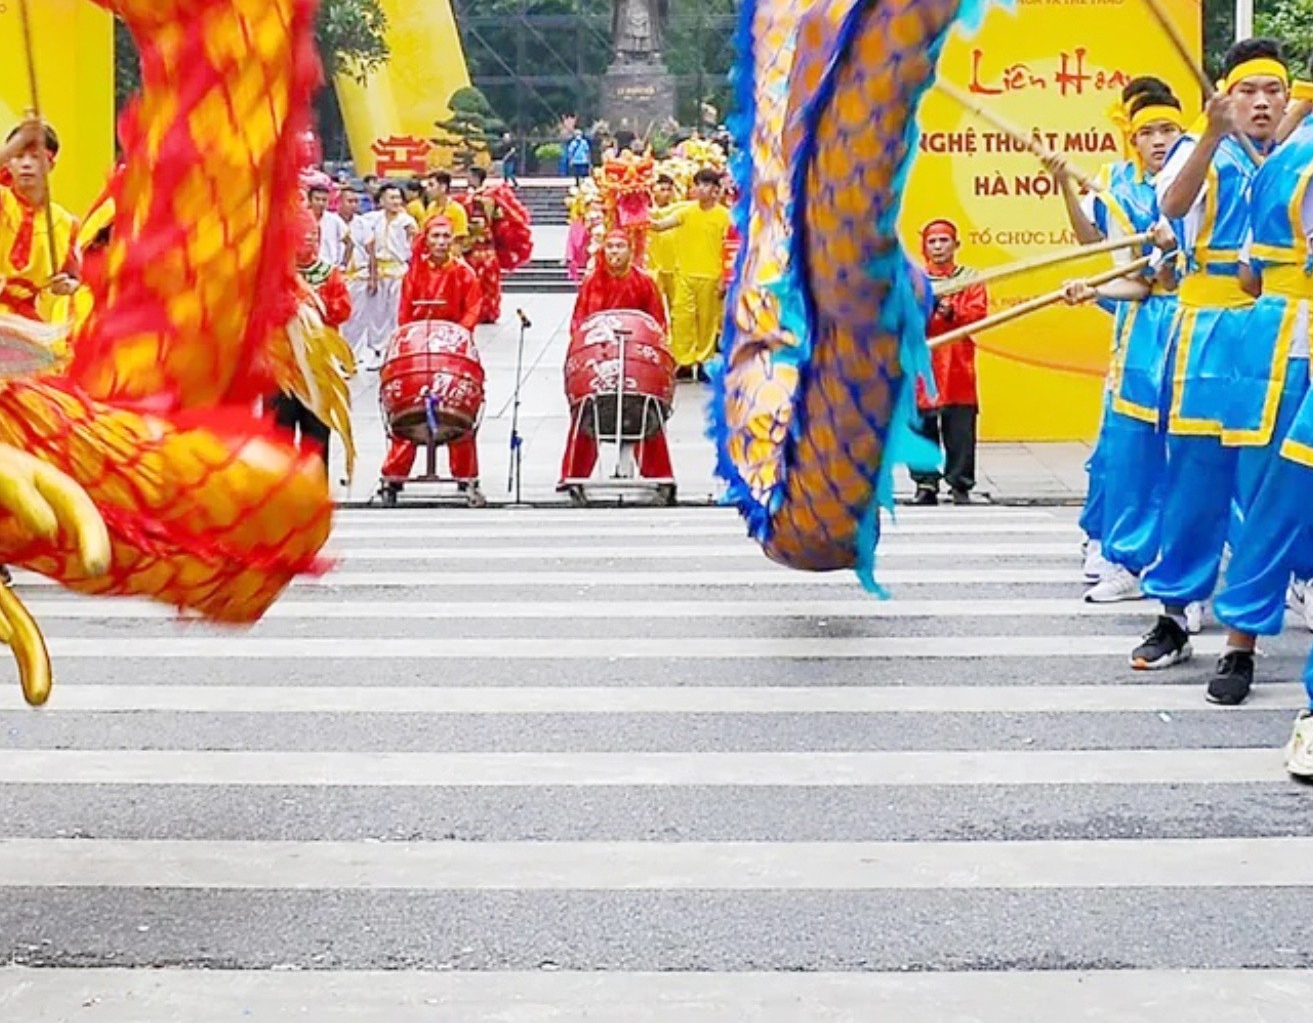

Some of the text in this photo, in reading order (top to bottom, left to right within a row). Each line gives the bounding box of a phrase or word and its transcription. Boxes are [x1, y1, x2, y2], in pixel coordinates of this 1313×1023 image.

[968, 47, 1132, 97] Liên Hoa
[1064, 127, 1117, 153] MÚA
[974, 170, 1008, 196] HÀ
[996, 228, 1045, 245] CHỨC
